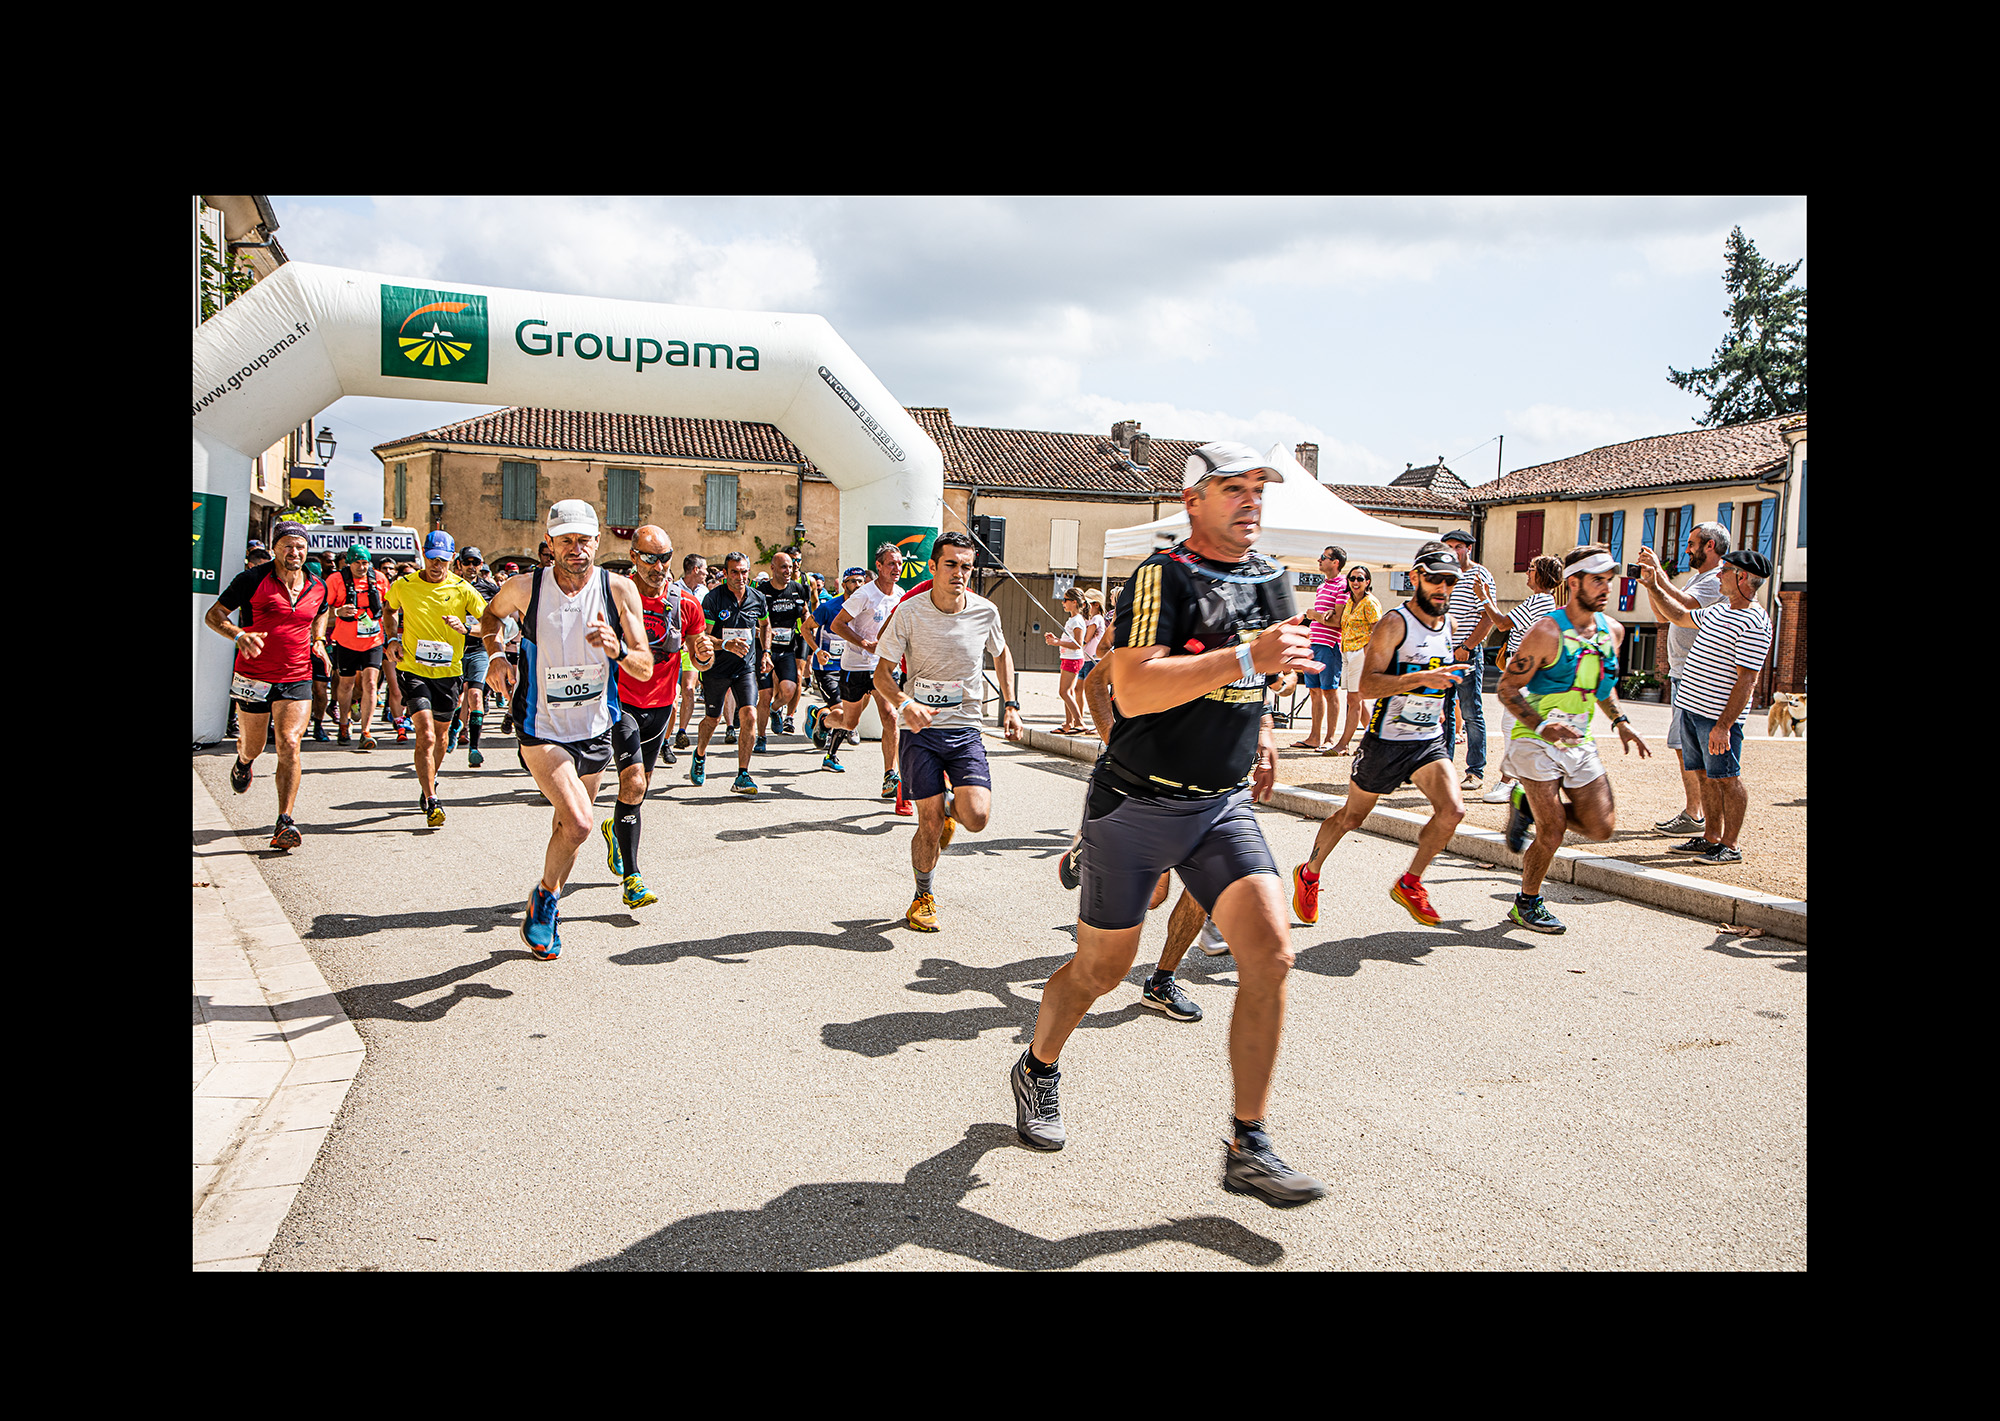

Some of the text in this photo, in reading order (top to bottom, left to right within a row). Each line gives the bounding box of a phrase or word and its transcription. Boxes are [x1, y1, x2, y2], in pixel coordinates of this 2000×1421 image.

[515, 318, 760, 373] Groupama
[193, 321, 311, 417] www.groupama.fr
[864, 416, 878, 431] 969
[877, 429, 891, 444] 320
[889, 443, 903, 458] 319
[308, 534, 412, 550] ANTENNE DE RISCLE
[427, 652, 443, 660] 175
[564, 683, 590, 696] 005
[927, 694, 948, 703] 024
[1414, 712, 1432, 722] 235
